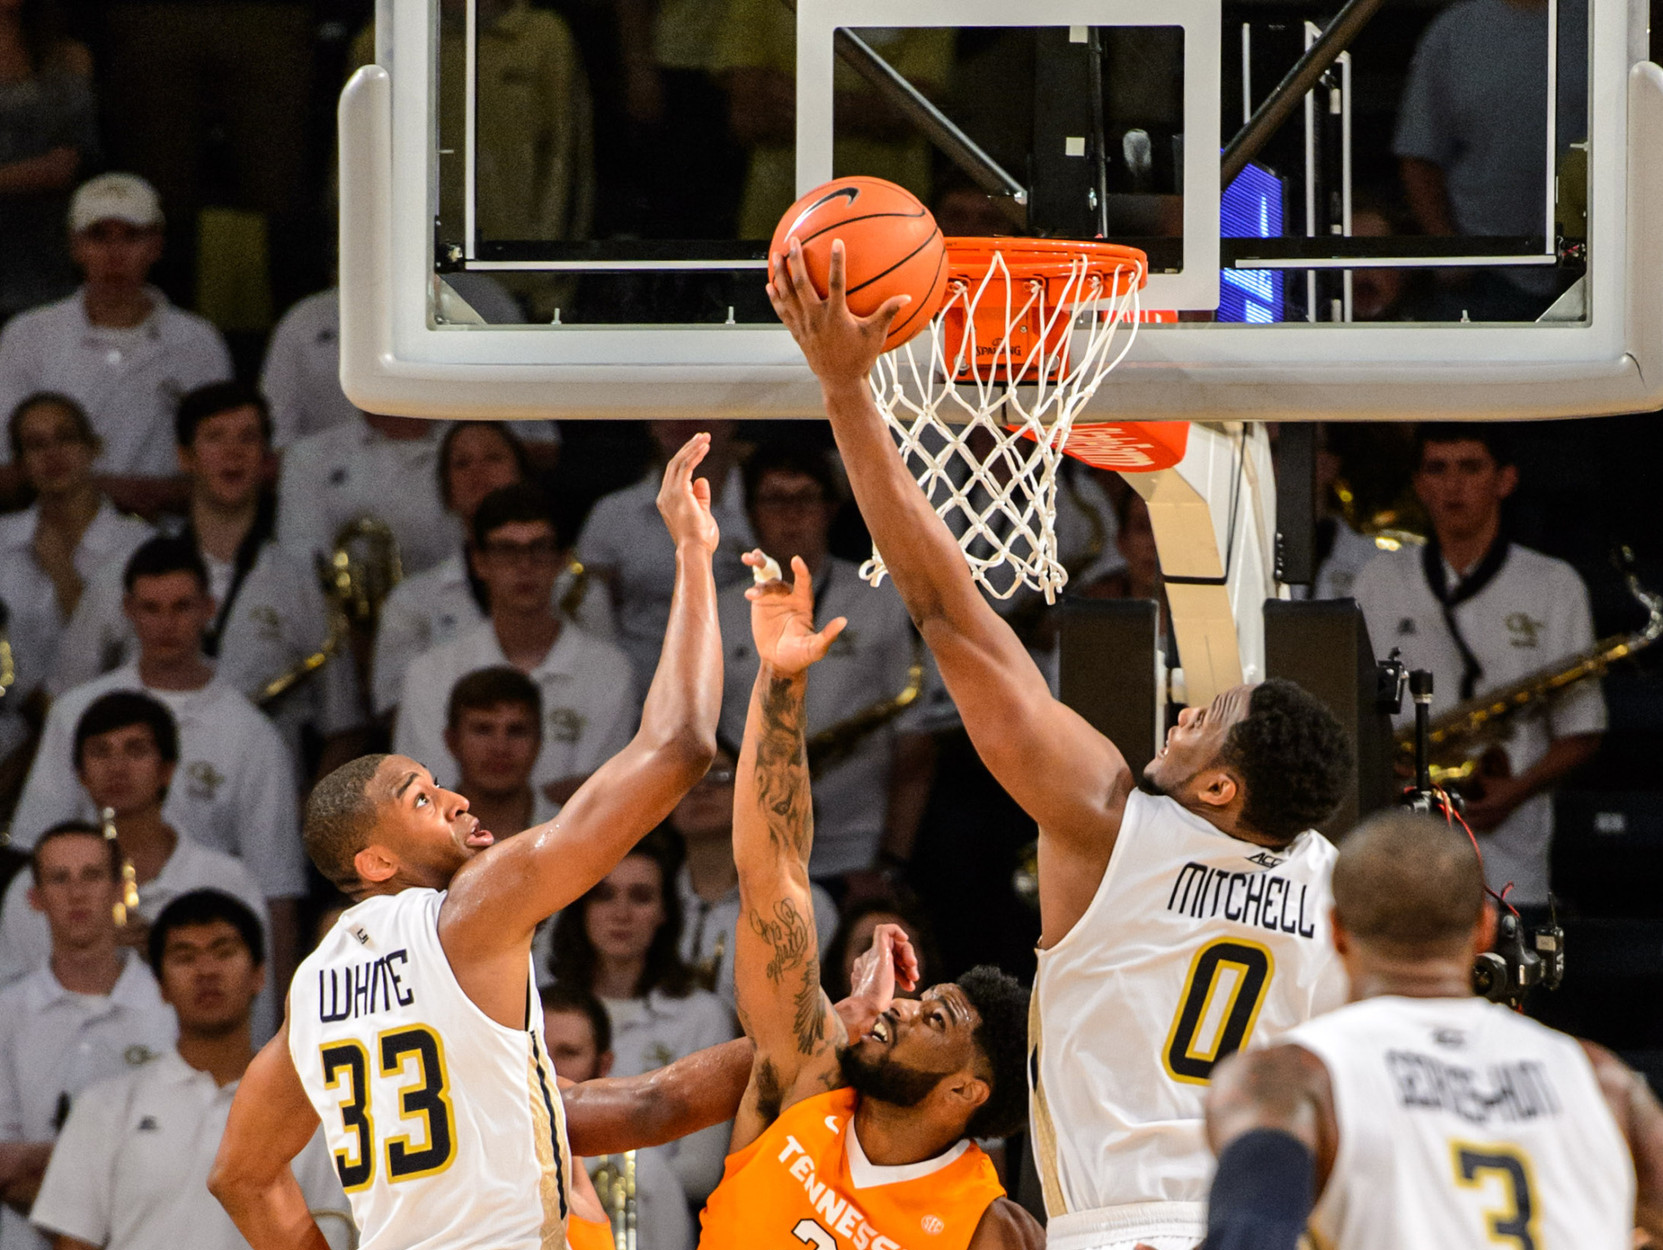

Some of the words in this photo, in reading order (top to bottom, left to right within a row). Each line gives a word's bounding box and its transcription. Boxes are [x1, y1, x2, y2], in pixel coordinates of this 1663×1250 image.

[1167, 861, 1315, 940] MITCHELL
[1161, 936, 1275, 1087] 0
[318, 1022, 459, 1194] 33
